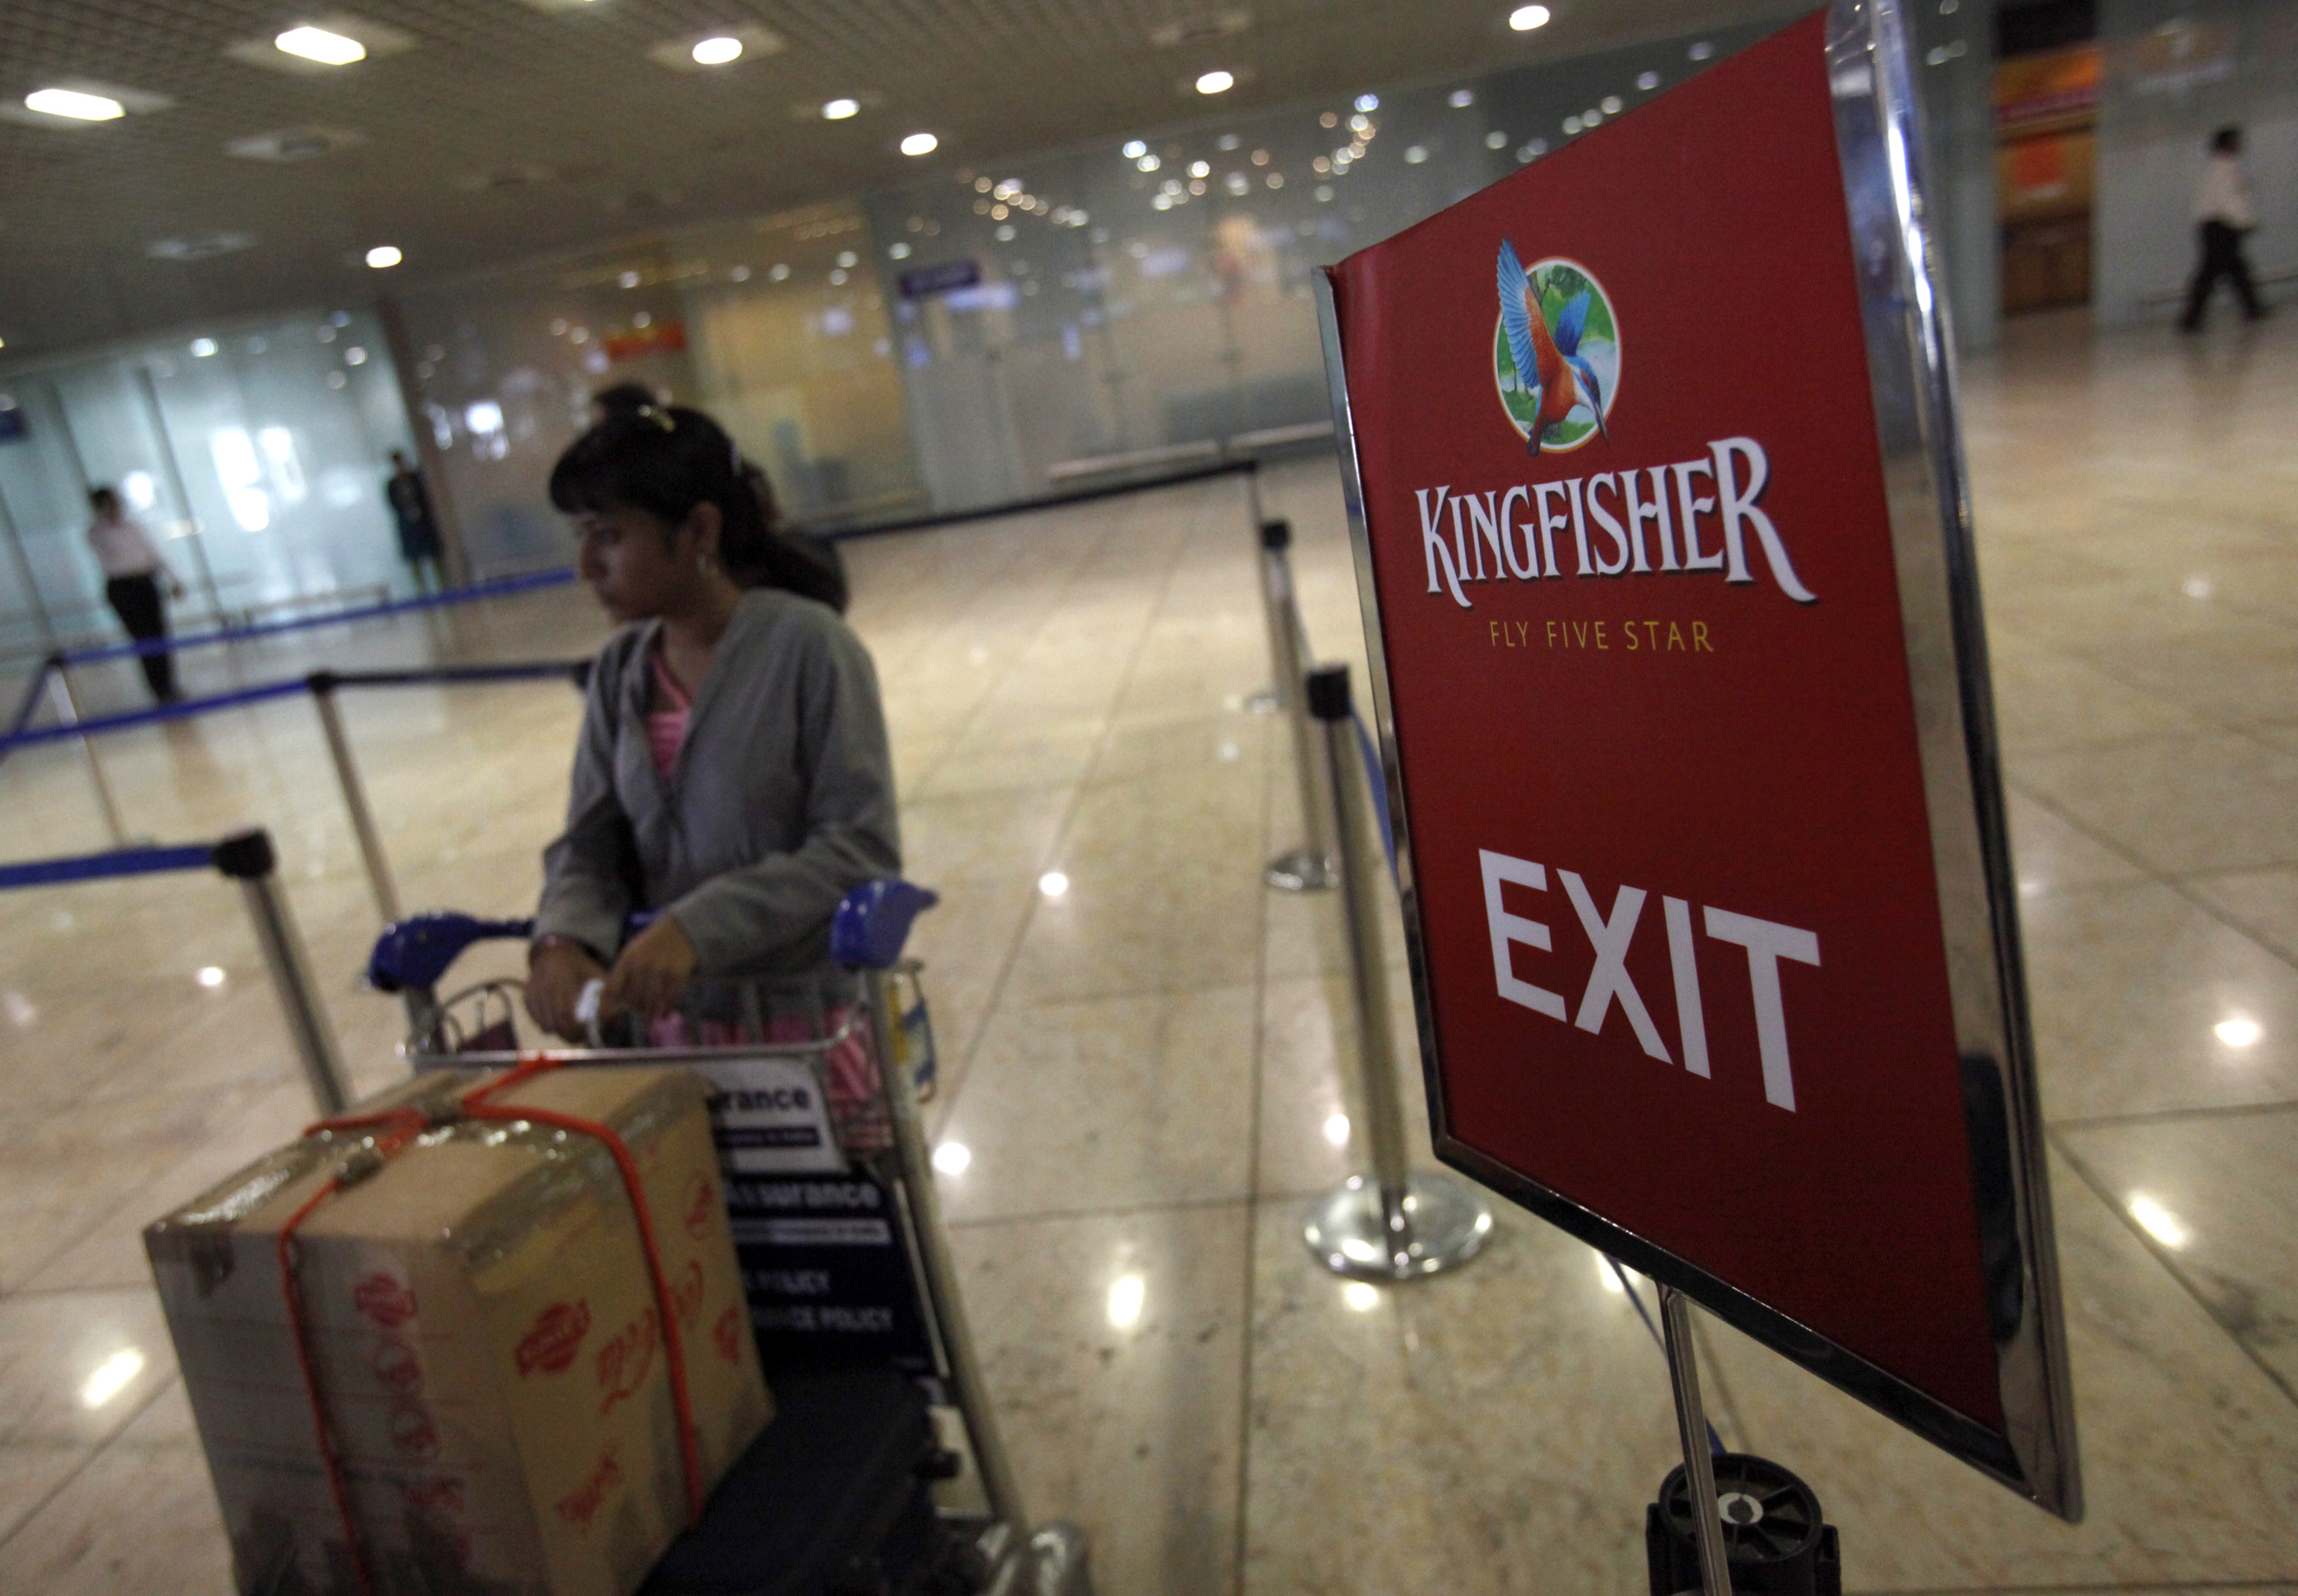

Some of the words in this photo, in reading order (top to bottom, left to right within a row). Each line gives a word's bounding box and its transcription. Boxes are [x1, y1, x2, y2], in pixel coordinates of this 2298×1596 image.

[1415, 436, 1818, 609] KINGFISHER
[1489, 621, 1528, 647] FLY
[1547, 621, 1609, 649] FIVE
[1624, 621, 1714, 652] STAR
[1479, 848, 1821, 1113] EXIT
